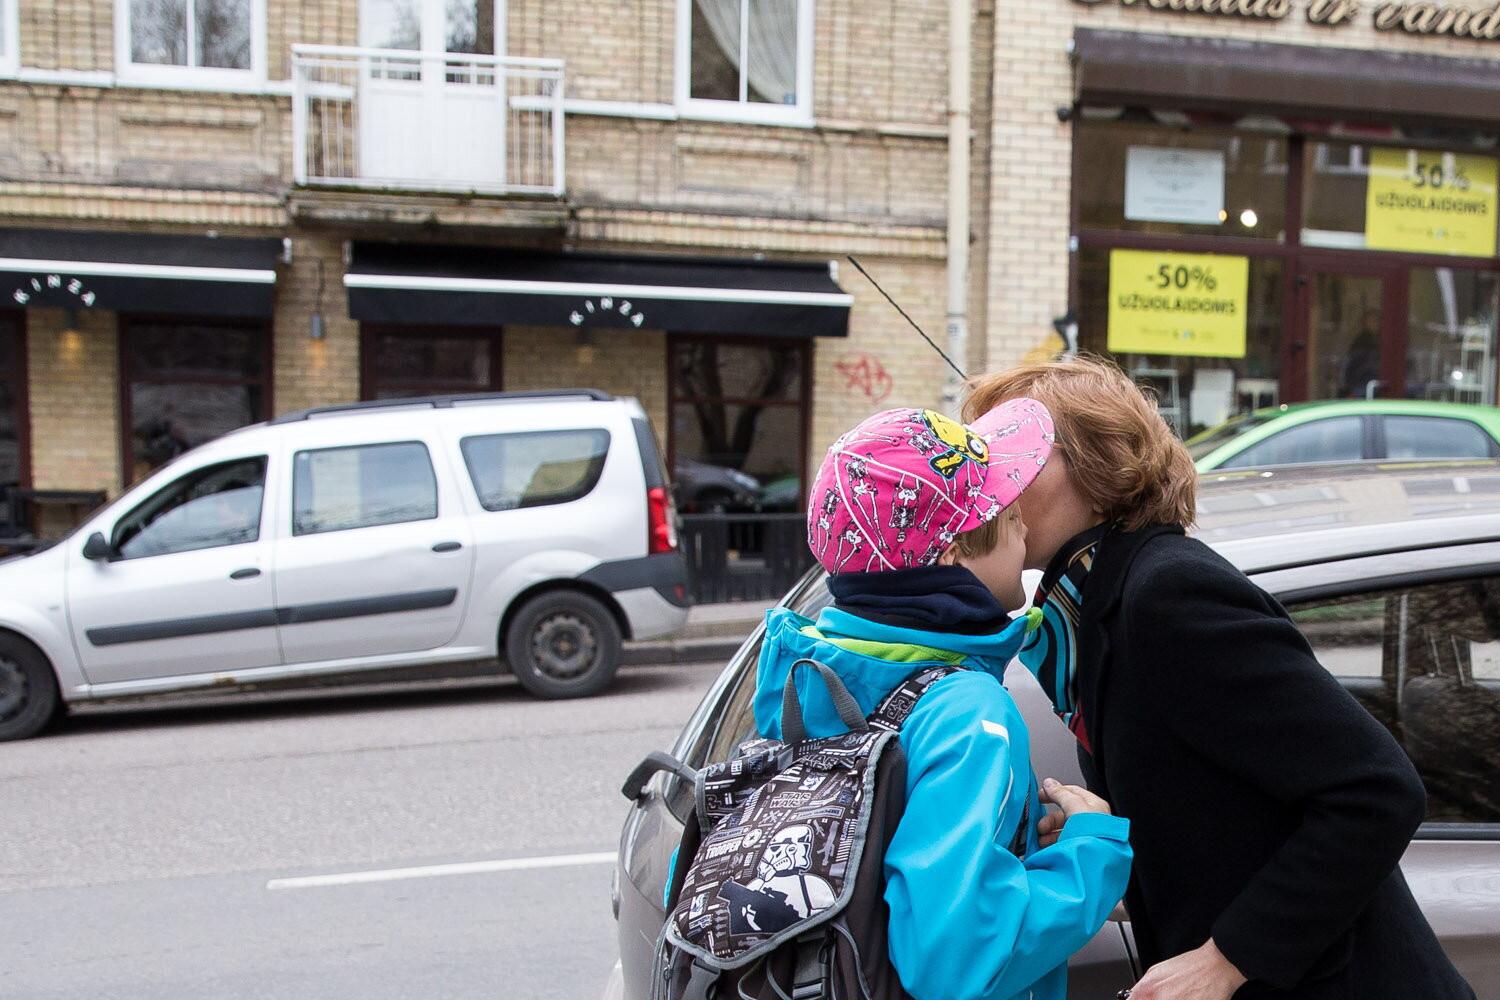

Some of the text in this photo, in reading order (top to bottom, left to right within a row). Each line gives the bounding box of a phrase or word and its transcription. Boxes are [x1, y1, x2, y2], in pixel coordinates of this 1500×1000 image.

[1145, 264, 1218, 292] -50%
[12, 274, 97, 307] KINZA
[568, 296, 645, 328] KINZA
[769, 798, 808, 809] WARS
[773, 791, 812, 800] STAR
[705, 840, 742, 860] TROOPER
